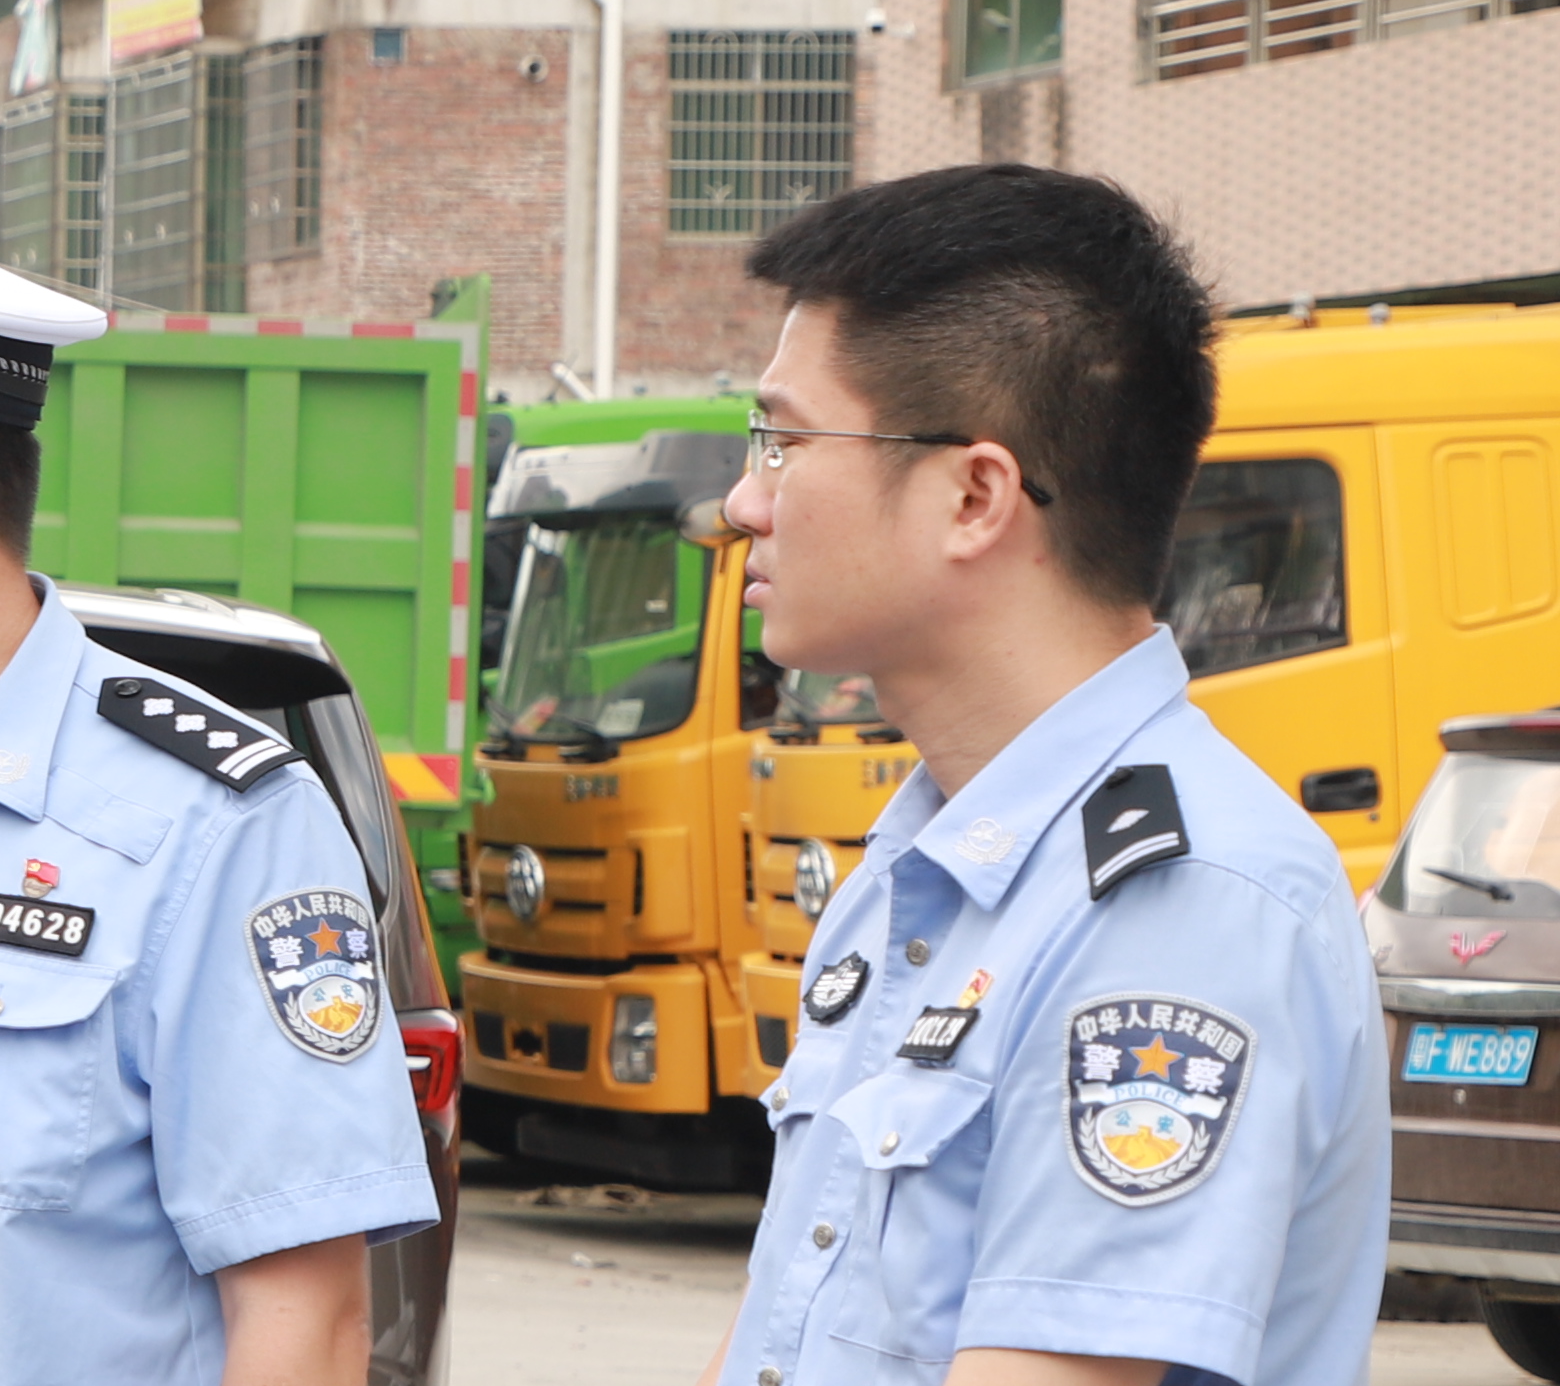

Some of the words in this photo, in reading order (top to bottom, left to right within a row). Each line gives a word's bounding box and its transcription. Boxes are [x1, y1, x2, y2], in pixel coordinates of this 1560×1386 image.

[253, 894, 370, 938] 中华人民共和国
[269, 935, 304, 968] 警
[345, 928, 369, 959] 察
[304, 962, 352, 982] POLICE
[1076, 1003, 1245, 1062] 中华人民共和国
[1081, 1044, 1122, 1081] 警
[1183, 1057, 1226, 1094] 察
[1114, 1083, 1185, 1106] POLICE
